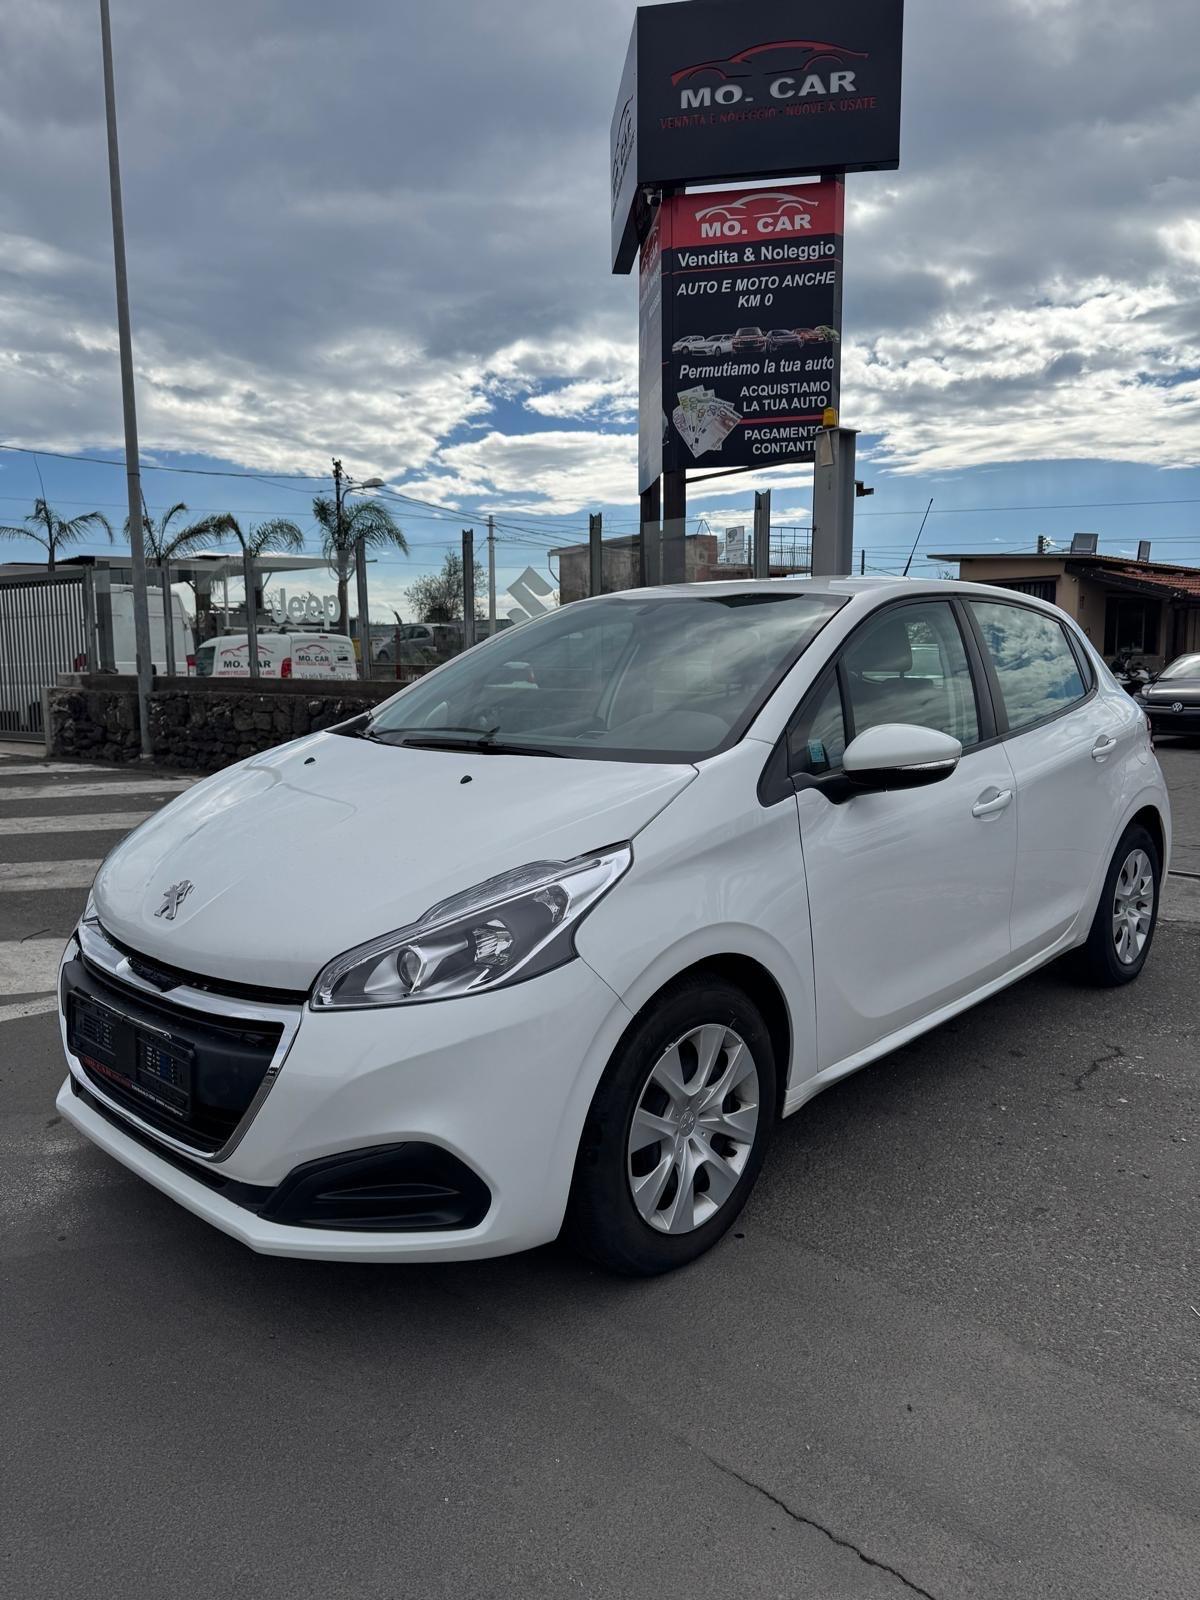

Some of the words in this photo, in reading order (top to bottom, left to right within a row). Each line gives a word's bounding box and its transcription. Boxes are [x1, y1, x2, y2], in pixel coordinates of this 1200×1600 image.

[680, 84, 754, 109] MO.
[769, 70, 857, 99] CAR
[784, 101, 825, 116] NUOVE
[839, 96, 877, 111] USATE
[700, 220, 748, 238] MO.
[756, 213, 812, 233] CAR
[678, 248, 739, 268] Vendita
[743, 247, 755, 262] &
[760, 241, 836, 261] Noleggio
[676, 280, 718, 296] AUTO
[721, 279, 732, 292] E
[735, 275, 780, 291] MOTO
[781, 271, 836, 288] ANCHE
[737, 294, 761, 308] KM
[764, 293, 774, 306] 0
[679, 361, 760, 380] Permutiamo
[763, 359, 776, 374] la
[779, 358, 801, 373] tua
[804, 356, 835, 371] auto
[739, 380, 831, 398] ACQUISTIAMO
[743, 400, 760, 412] LA
[762, 398, 789, 410] TUA
[790, 395, 828, 409] AUTO
[272, 588, 342, 630] Jeep
[223, 660, 244, 669] MO.
